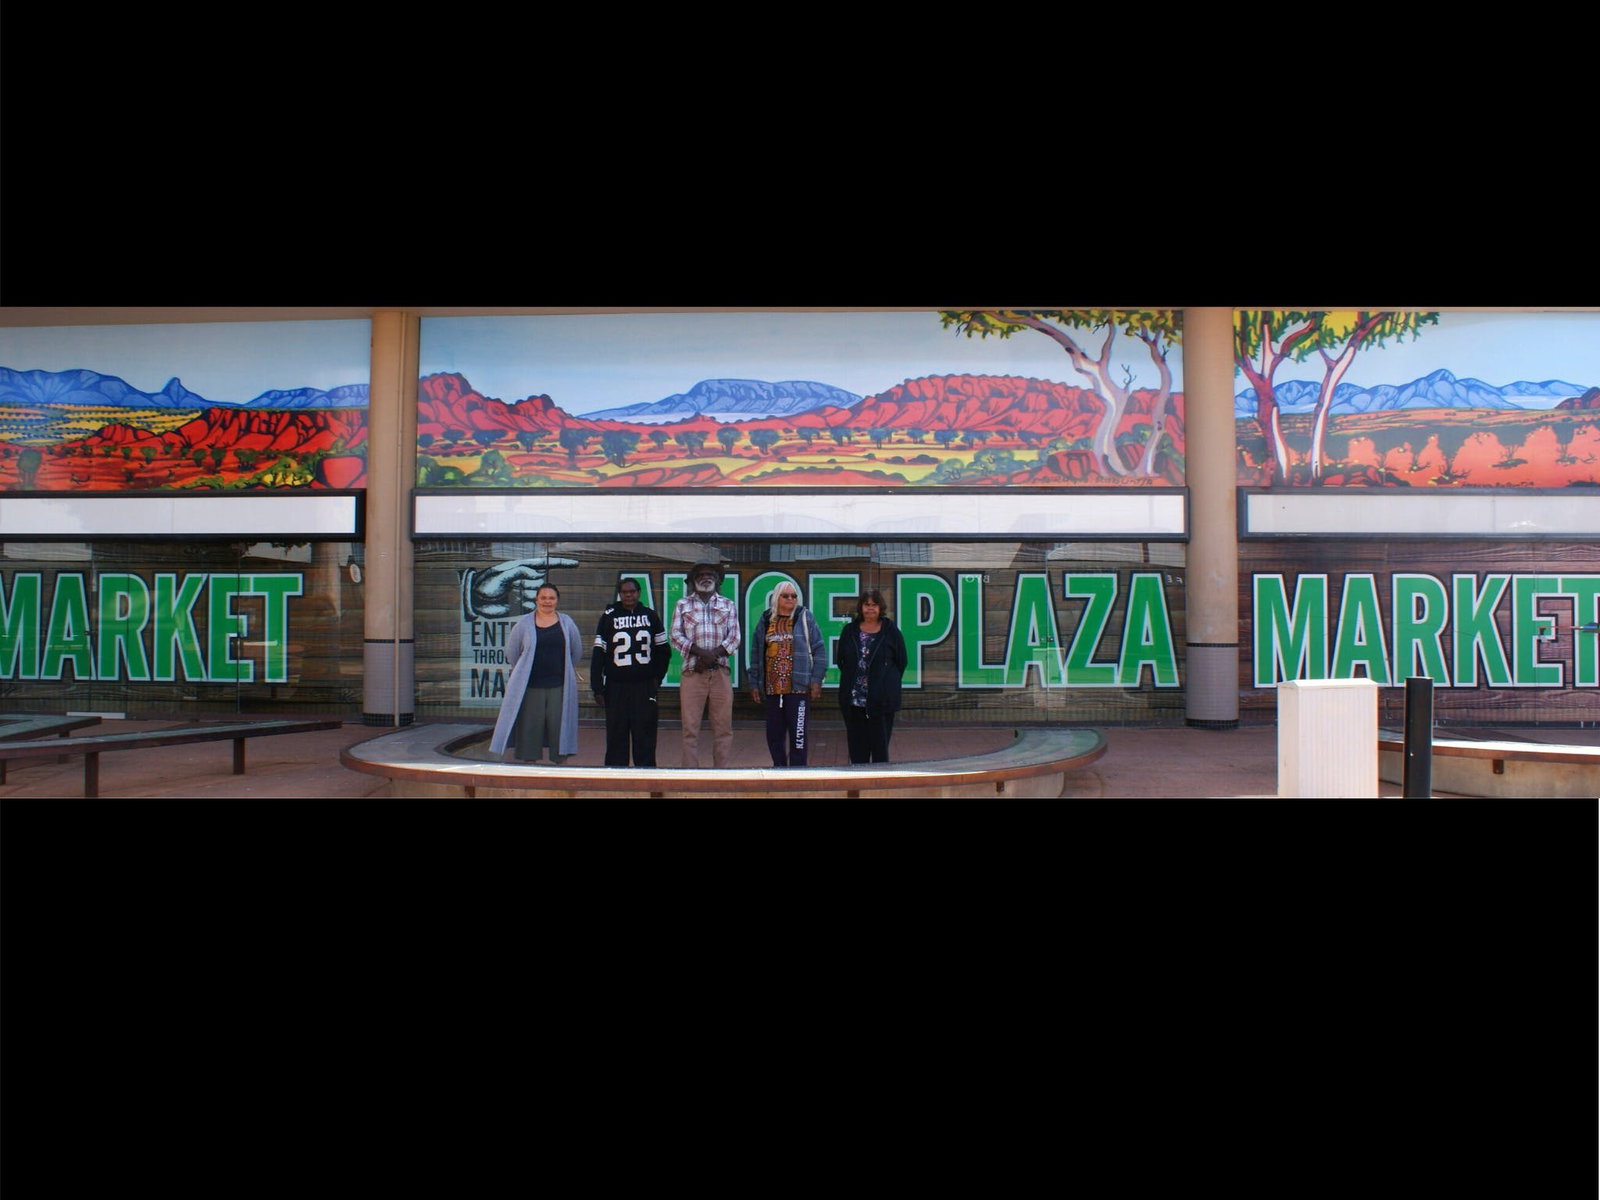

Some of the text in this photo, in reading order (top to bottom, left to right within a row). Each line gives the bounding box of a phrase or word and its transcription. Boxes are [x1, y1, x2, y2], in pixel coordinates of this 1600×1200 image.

[471, 621, 516, 647] ENT
[612, 630, 652, 667] 23
[897, 573, 1181, 689] PLAZA
[1253, 573, 1600, 689] MARKET
[795, 706, 806, 749] BROOKLYN
